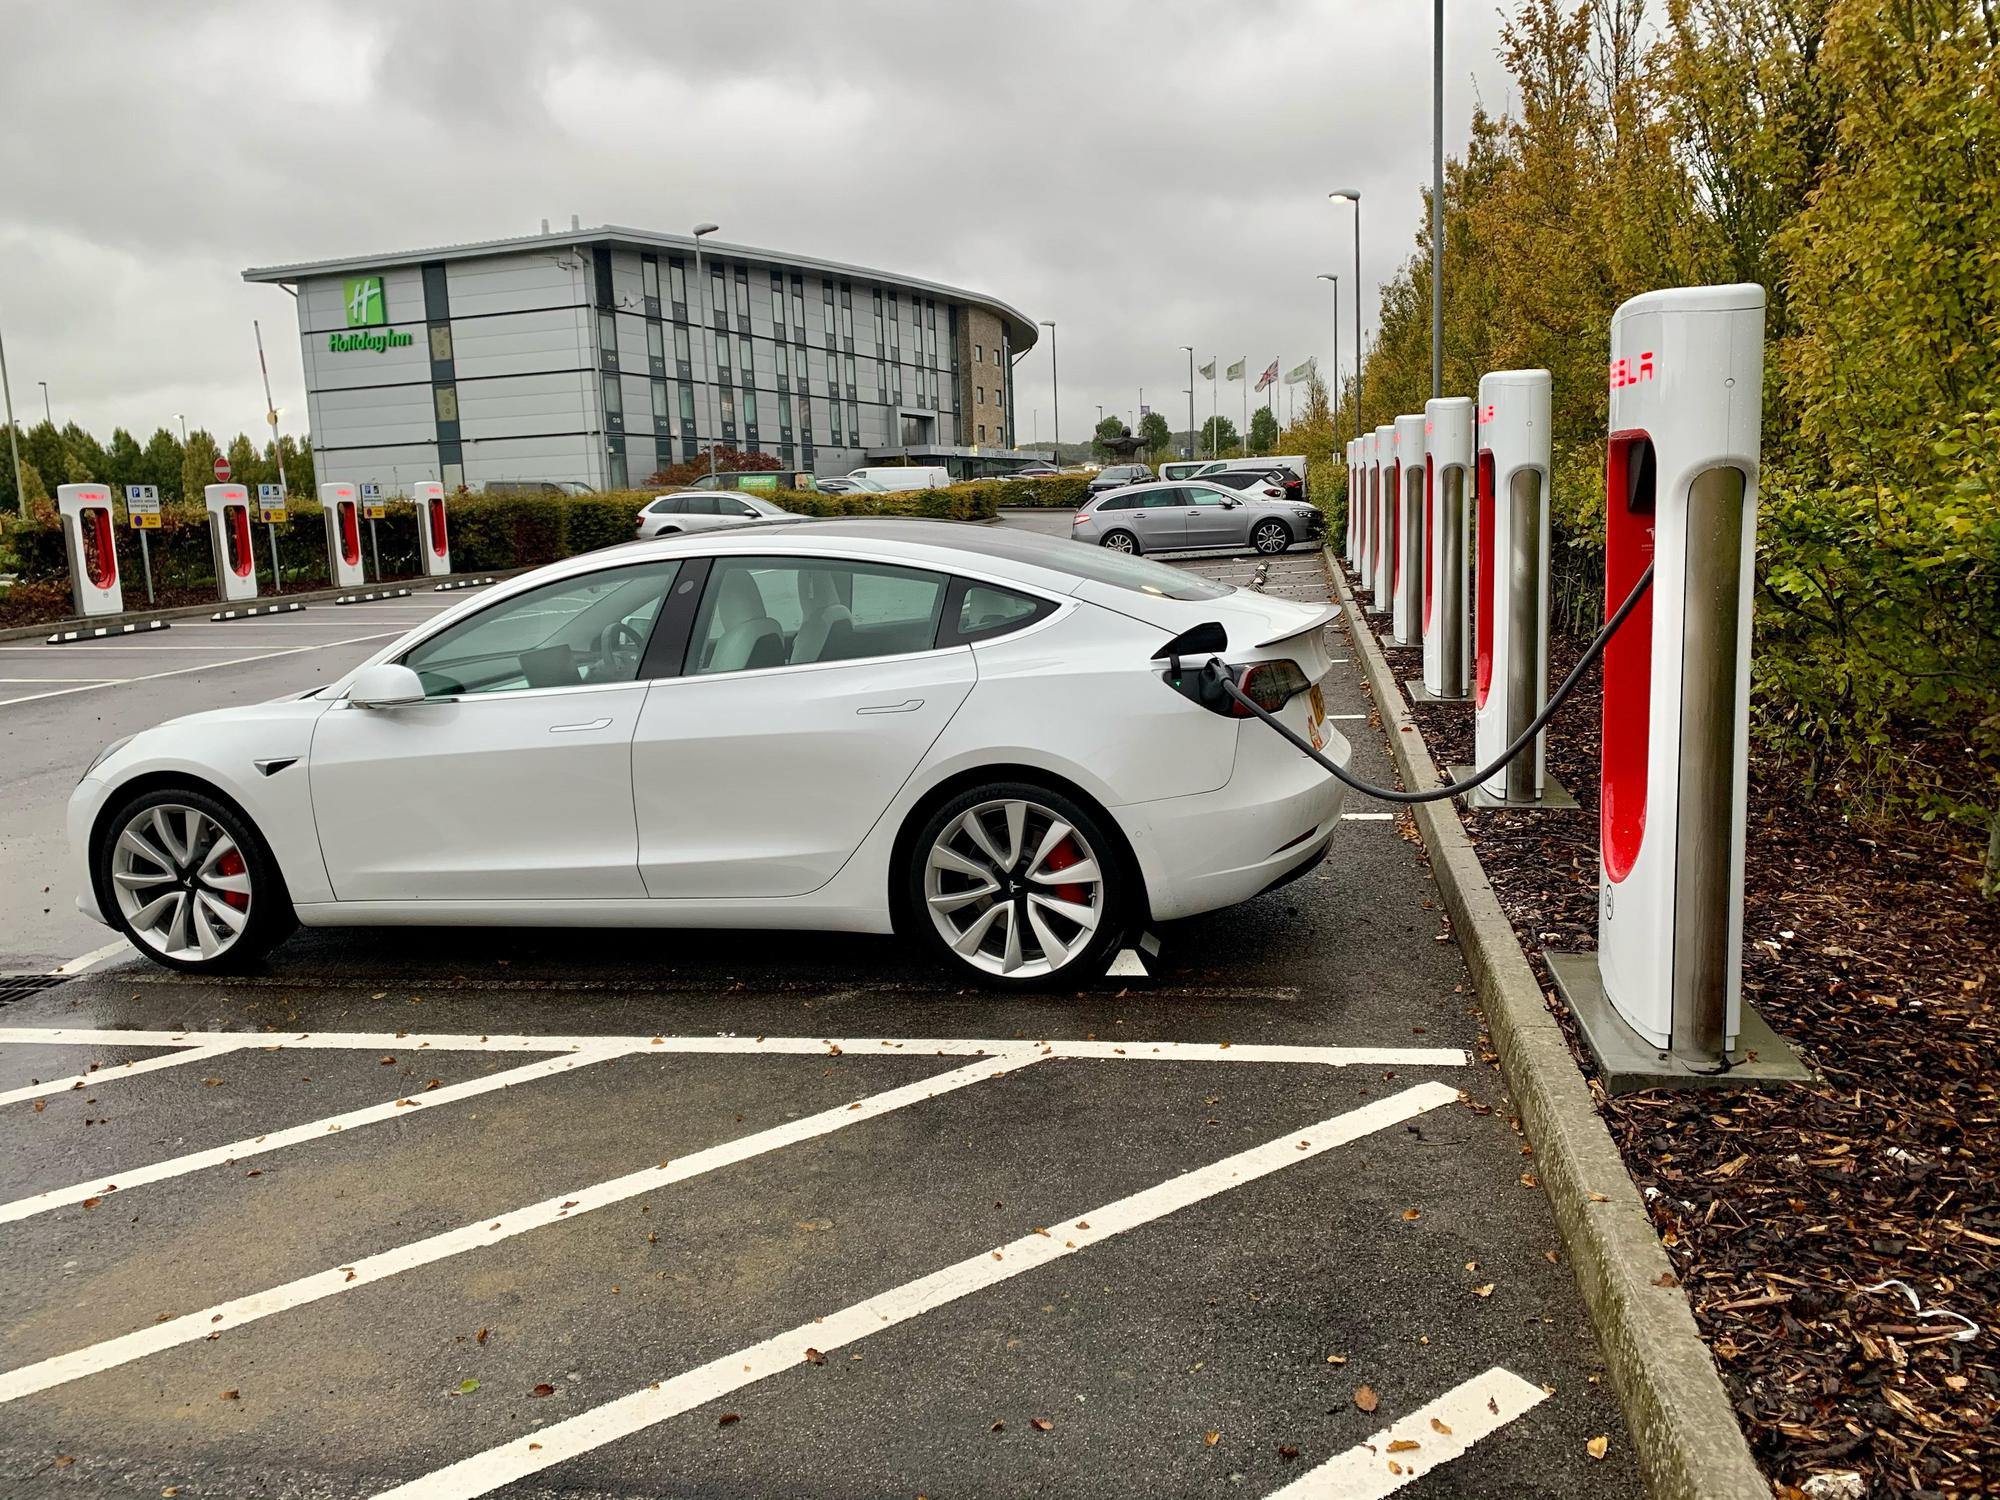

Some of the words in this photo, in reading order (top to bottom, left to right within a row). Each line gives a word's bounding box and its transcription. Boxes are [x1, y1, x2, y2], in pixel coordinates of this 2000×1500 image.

[328, 331, 386, 353] Holiday
[386, 328, 413, 347] Inn
[1610, 352, 1653, 389] ESLA
